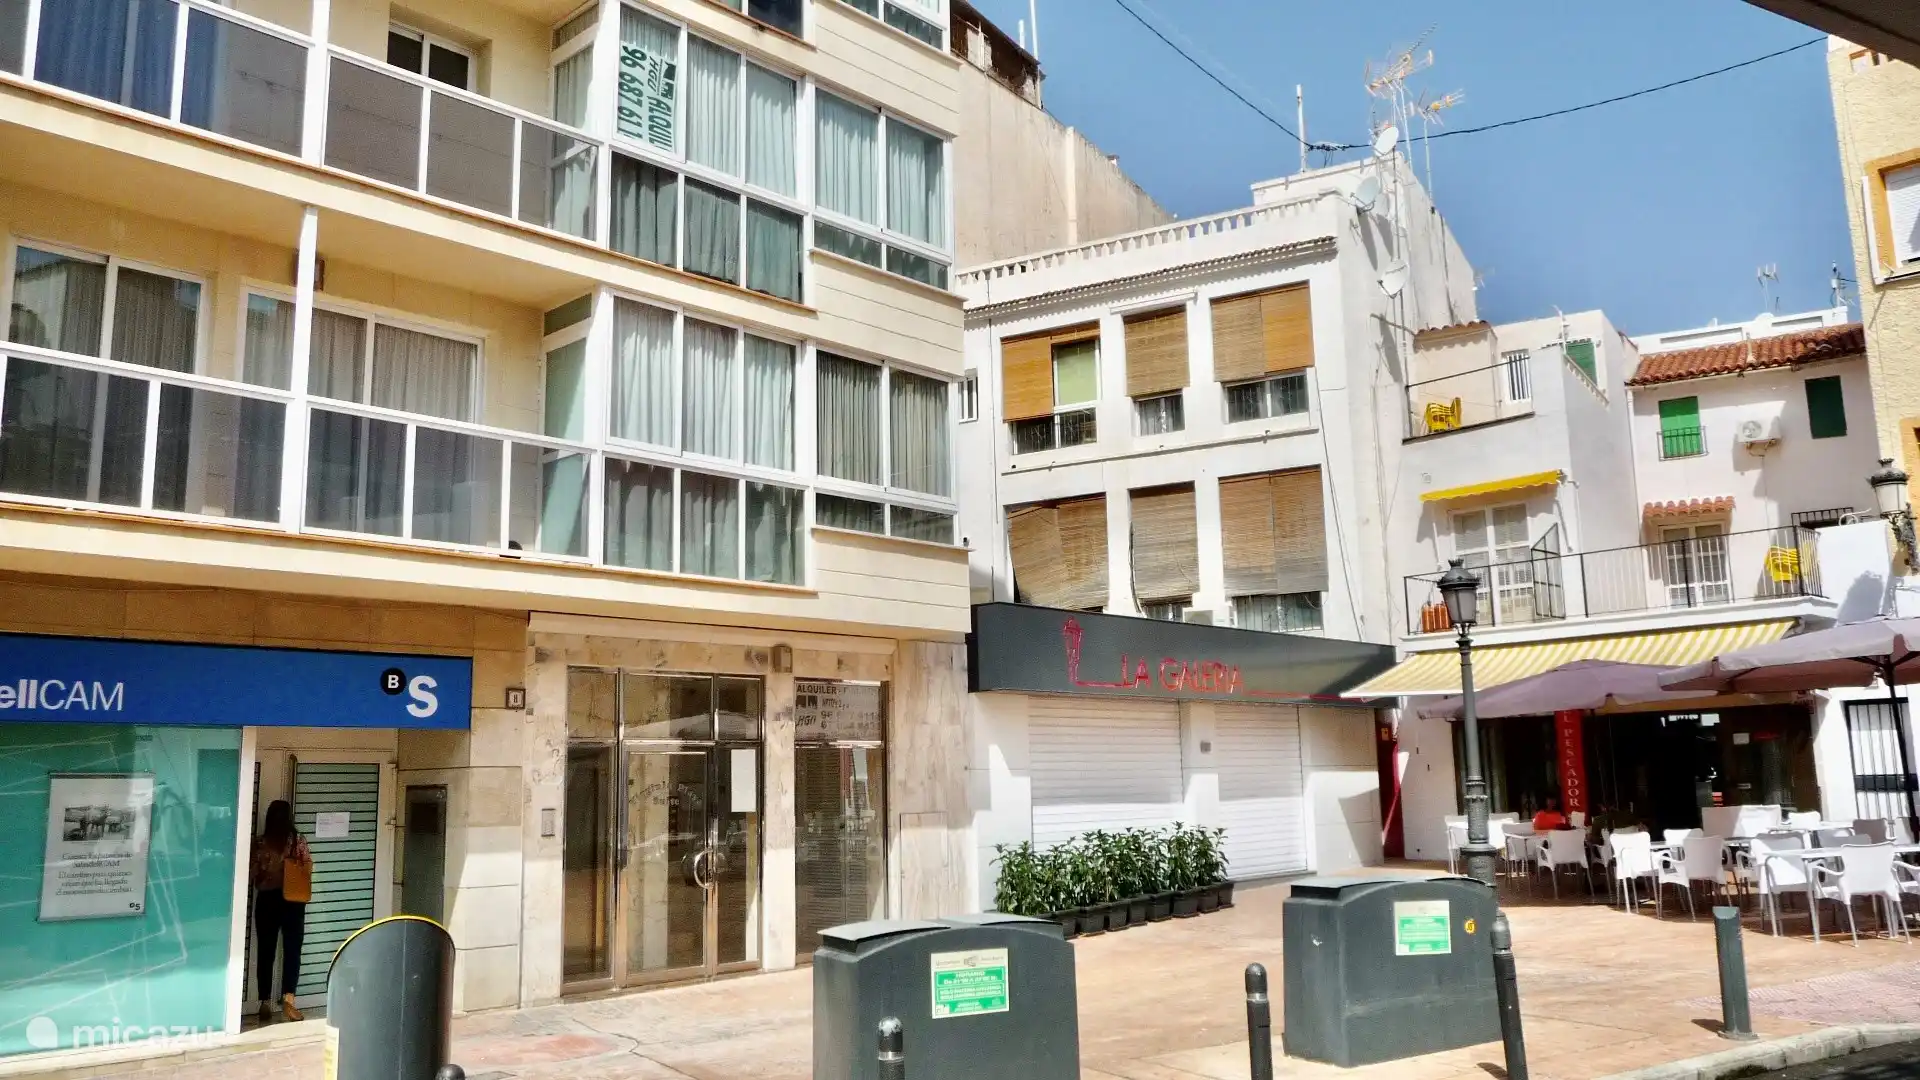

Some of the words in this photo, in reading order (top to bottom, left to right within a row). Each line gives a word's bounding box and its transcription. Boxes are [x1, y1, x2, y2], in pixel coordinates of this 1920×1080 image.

[621, 45, 647, 70] 96
[618, 71, 645, 108] 687
[647, 95, 673, 152] ALQUIL
[796, 684, 837, 694] ALQUILER
[1122, 653, 1152, 689] LA
[1159, 656, 1245, 694] GALERIA
[1564, 728, 1580, 807] PESCADOR
